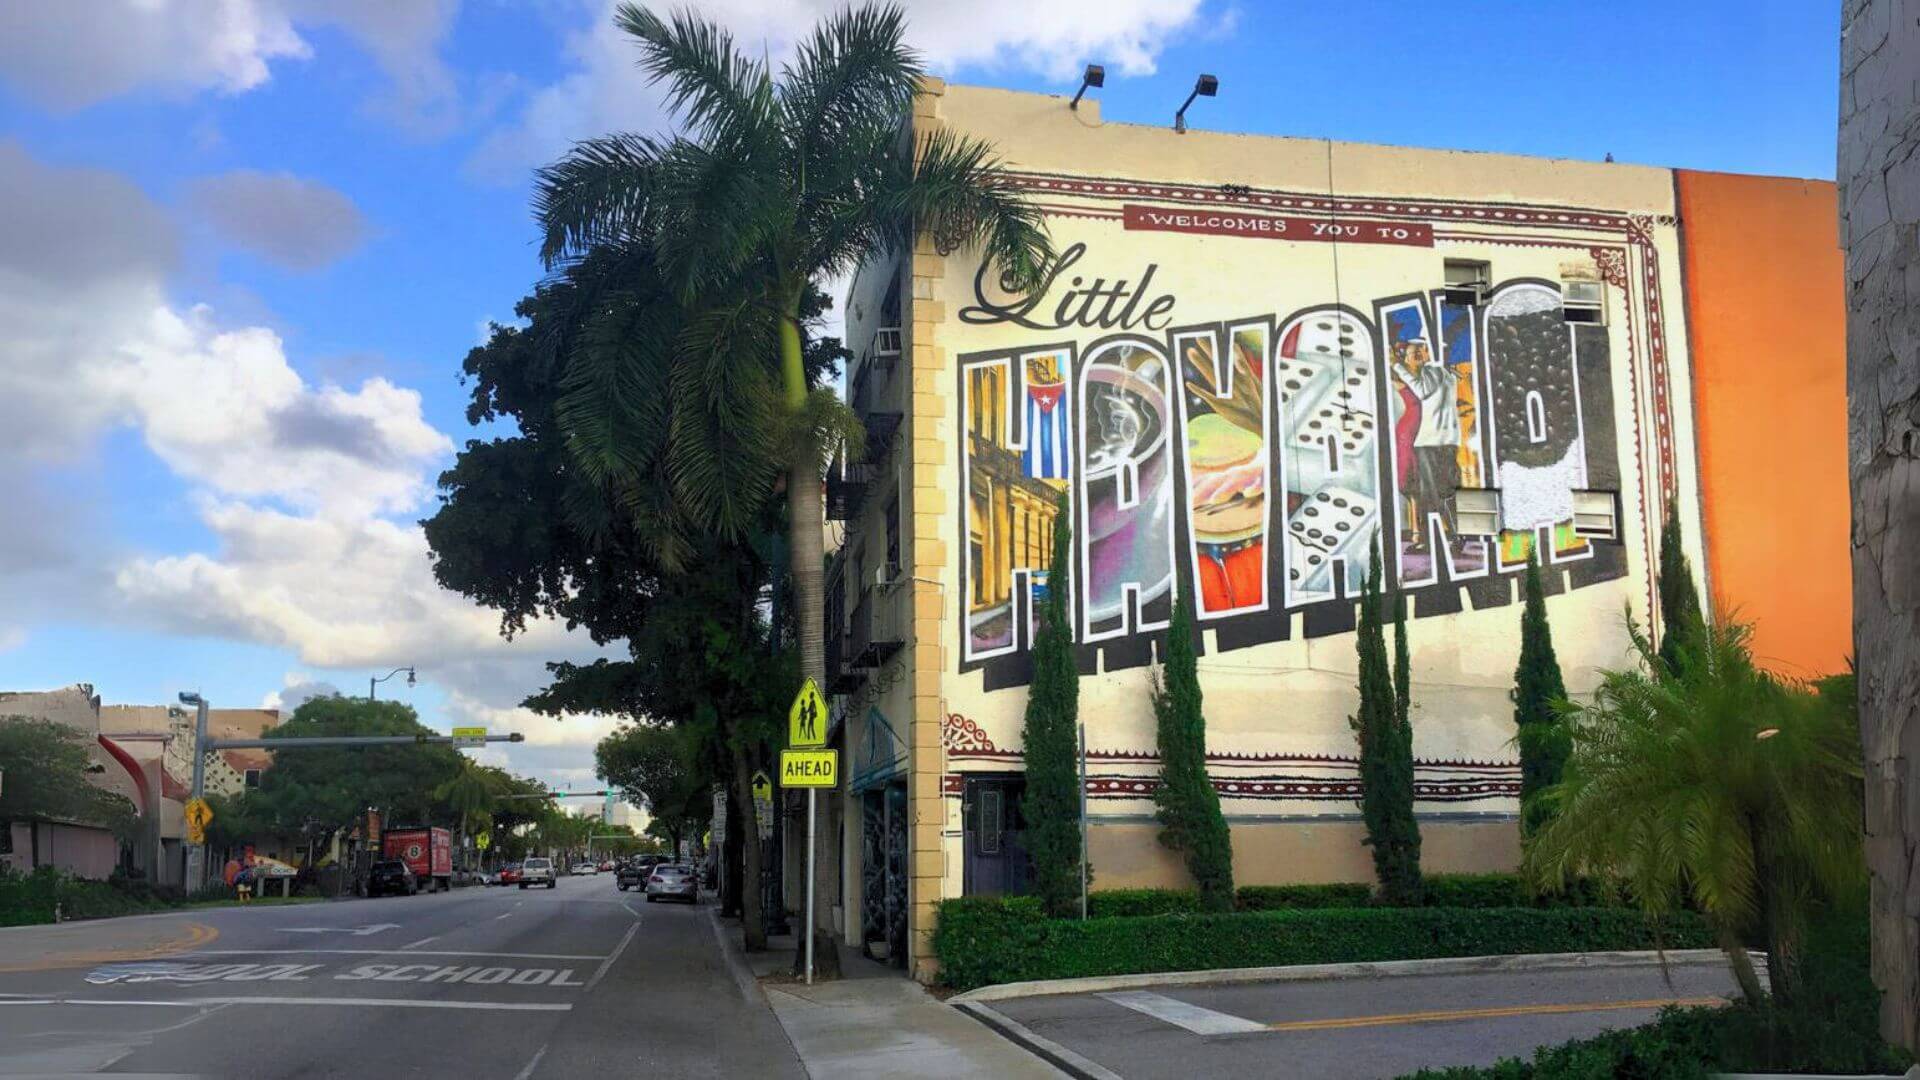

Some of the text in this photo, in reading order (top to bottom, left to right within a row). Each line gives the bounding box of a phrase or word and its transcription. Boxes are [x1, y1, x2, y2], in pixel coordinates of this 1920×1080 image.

[1149, 213, 1409, 239] WELCOMES YOU TO
[958, 242, 1176, 330] Little
[958, 277, 1604, 675] HAVANA
[785, 760, 832, 776] AHEAD
[334, 963, 585, 987] SCHOOL
